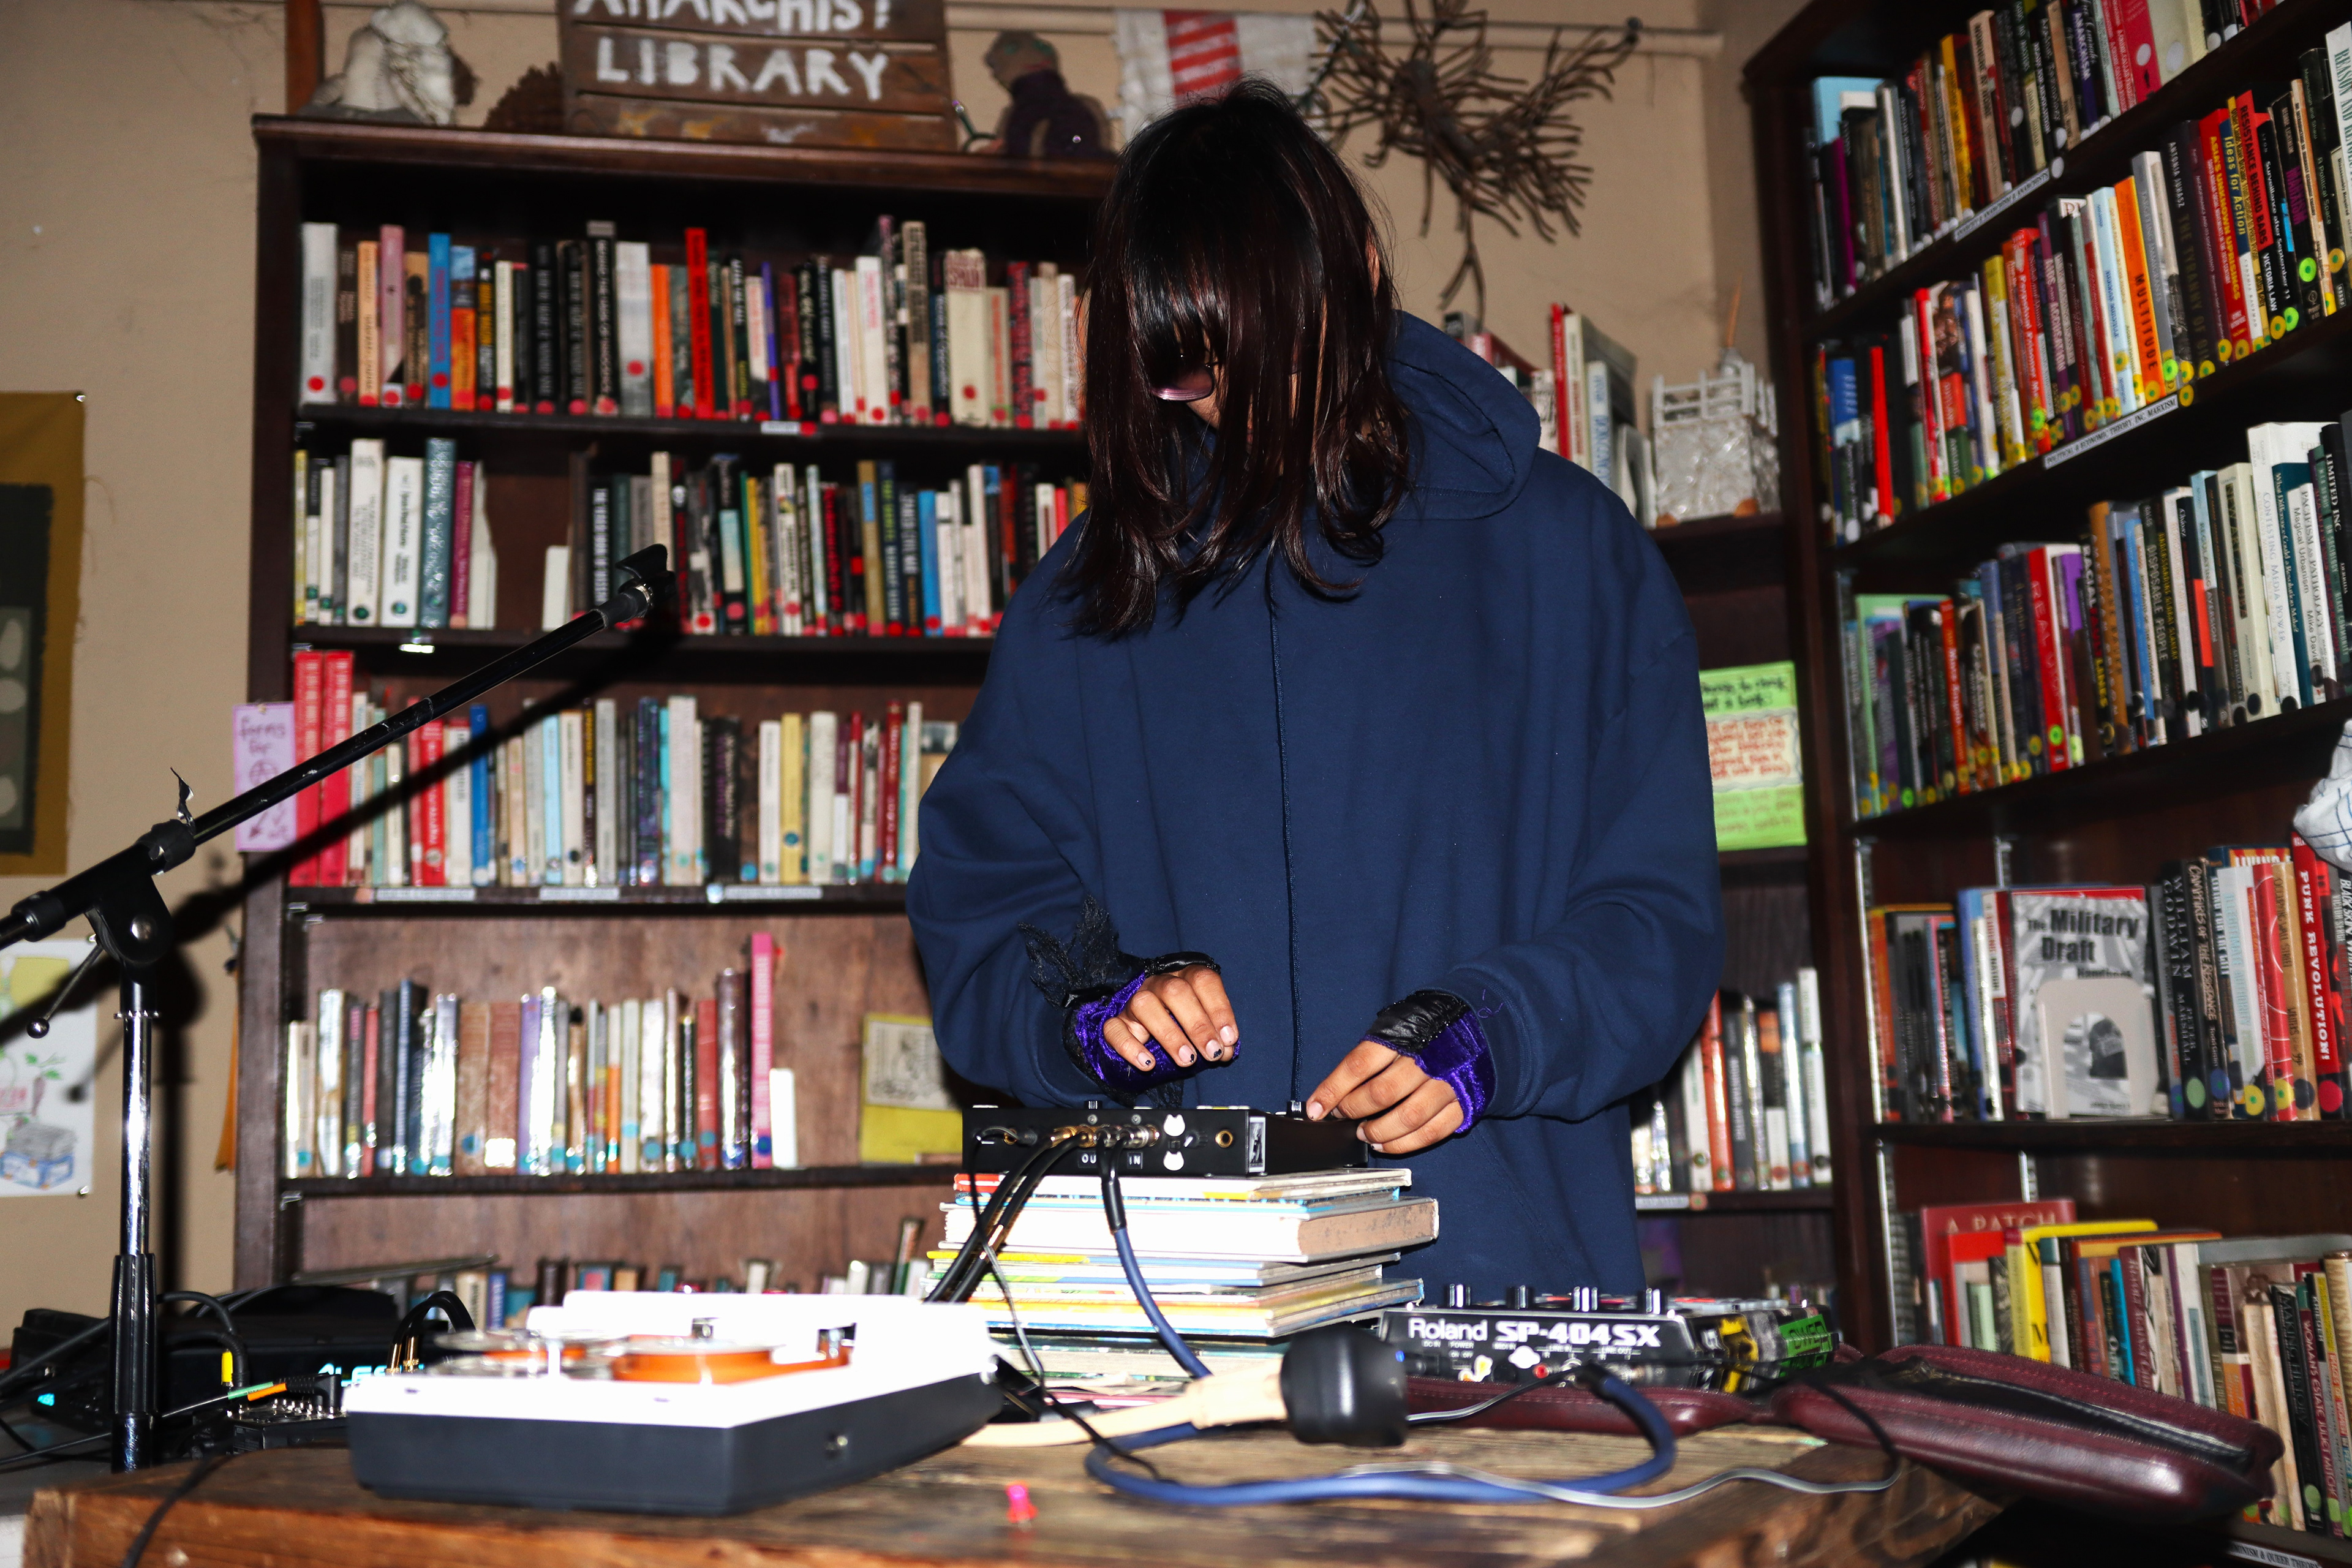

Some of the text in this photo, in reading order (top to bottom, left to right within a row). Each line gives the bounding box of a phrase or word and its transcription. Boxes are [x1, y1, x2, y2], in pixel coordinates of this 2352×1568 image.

[596, 36, 888, 101] LIBRARY
[2072, 12, 2091, 81] ANARCHISM
[2169, 141, 2185, 208] ANTONIA JUHASZ
[2224, 135, 2246, 235] Ideas for Action
[2241, 105, 2268, 245] RESISTANCE BEHIND BARS
[2285, 165, 2309, 226] MARXISM
[2318, 165, 2329, 198] Political
[2337, 157, 2346, 192] Disassembly
[2179, 214, 2192, 243] THE
[2209, 136, 2241, 300] ASIA'S UNKNOWN UPRISINGS
[2264, 160, 2291, 300] Surveillance after September 11
[2182, 245, 2203, 310] TYRANNY
[2263, 252, 2278, 312] VICTORIA LAW
[2020, 274, 2032, 330] Perpetual
[2026, 331, 2036, 379] Prisoner
[2135, 273, 2157, 372] MULTITUDE
[2193, 315, 2205, 332] OF
[2147, 399, 2177, 417] MARXISM
[2326, 453, 2339, 507] LIMITED
[2278, 494, 2286, 533] Difference
[2332, 508, 2342, 533] INC
[2263, 491, 2286, 643] CONTESTING MEDIA POWER
[2282, 533, 2291, 561] Could
[2294, 507, 2304, 546] Magical
[2299, 546, 2310, 594] Urbanism
[2301, 490, 2324, 629] PACIFISM PATHOLOGY
[2146, 544, 2169, 663] DISPOSABLE PEOPLE
[2199, 522, 2219, 644] REGULATING AVERSION
[2285, 565, 2295, 606] Revolution
[2339, 561, 2349, 595] DERRIDA
[2082, 544, 2097, 608] RACIAL
[2095, 658, 2108, 709] LINES
[2291, 606, 2299, 633] Make?
[2274, 876, 2293, 968] OCCUPYING WALL STREET
[2332, 894, 2343, 919] VICTOR
[2340, 878, 2352, 910] BLACK
[2041, 936, 2095, 963] Draft
[2050, 909, 2139, 940] Military
[2163, 879, 2182, 977] GODWIN
[2173, 875, 2192, 978] WILLIAM
[2188, 864, 2218, 1022] CAMPFIRES OF THE RESISTANCE
[2210, 876, 2230, 976] LIVING FOR THE CITY
[2334, 919, 2346, 943] SERGE
[2299, 870, 2331, 1061] PUNK REVOLUTION!
[2177, 992, 2192, 1066] MARSHALL
[2186, 1006, 2196, 1049] PETER
[1081, 1153, 1097, 1164] OU
[1129, 1155, 1141, 1165] IN
[1972, 1212, 2057, 1231] PATCH
[1408, 1316, 1489, 1342] Roland
[1494, 1319, 1662, 1348] SP-404SX
[2312, 1295, 2324, 1342] KRIEGER
[2281, 1295, 2309, 1427] MAKING HISTORY
[2310, 1378, 2331, 1457] ESTATE JULIET
[2334, 1400, 2348, 1437] WOMEN
[2266, 1551, 2290, 1566] QUEER
